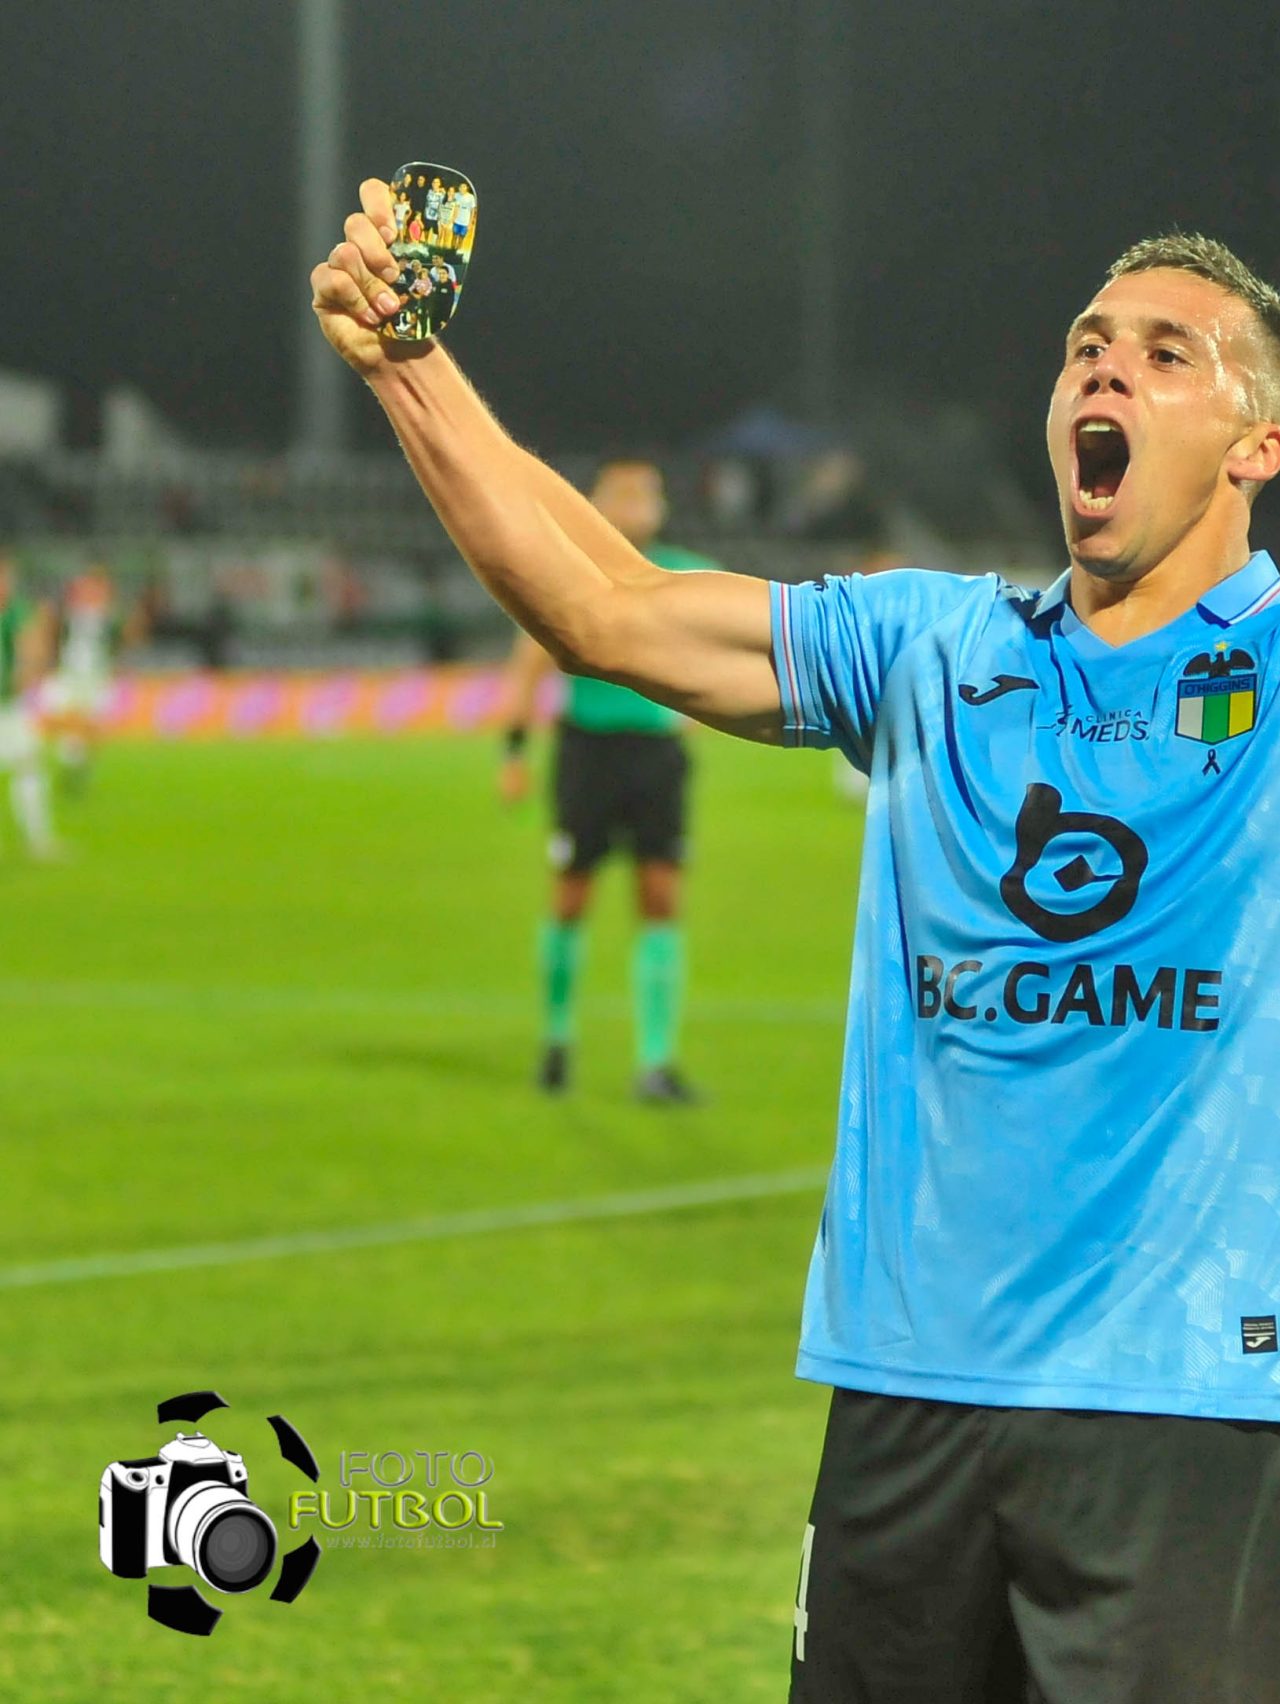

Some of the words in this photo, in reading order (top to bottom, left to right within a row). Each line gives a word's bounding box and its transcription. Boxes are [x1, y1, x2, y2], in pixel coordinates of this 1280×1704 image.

[1184, 678, 1251, 697] O'HIGGINS
[1085, 708, 1143, 724] CLINICA
[916, 954, 1223, 1032] BC.GAME
